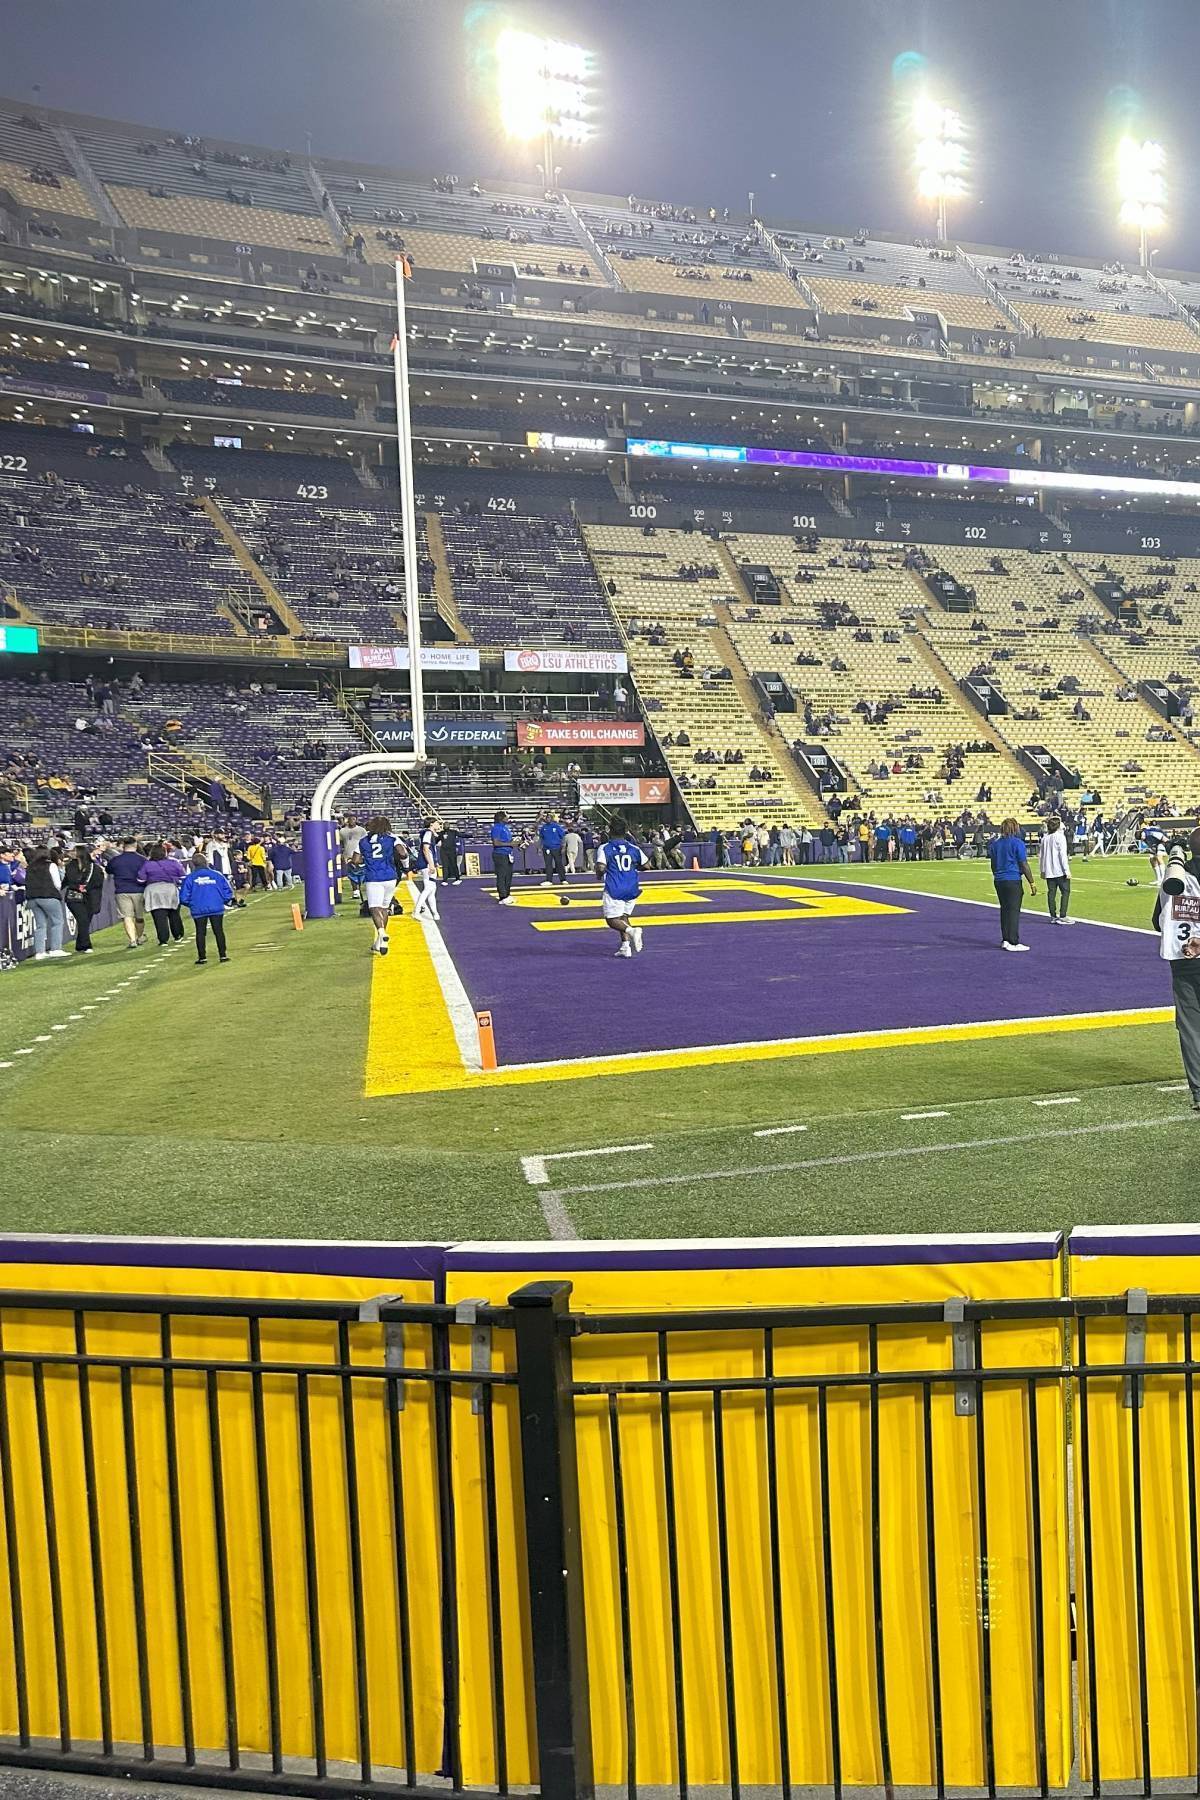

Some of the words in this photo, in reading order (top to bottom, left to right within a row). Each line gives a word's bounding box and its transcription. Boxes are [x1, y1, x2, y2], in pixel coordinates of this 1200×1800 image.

[235, 246, 252, 255] 612
[487, 266, 504, 276] 613
[296, 484, 328, 499] 423
[487, 497, 517, 512] 424
[629, 505, 657, 519] 100
[792, 515, 817, 529] 101
[964, 526, 987, 540] 102
[1140, 537, 1161, 549] 103
[543, 658, 561, 669] LSU
[564, 659, 618, 670] ATHLETICS
[450, 730, 502, 740] FEDERAL
[546, 729, 571, 739] TAKE
[572, 729, 579, 739] 5
[580, 729, 597, 739] OIL
[597, 729, 639, 739] CHANGE
[813, 757, 825, 765] 101
[581, 783, 633, 791] WWL
[372, 842, 384, 859] 2
[614, 854, 632, 872] 10
[1177, 922, 1191, 941] 3
